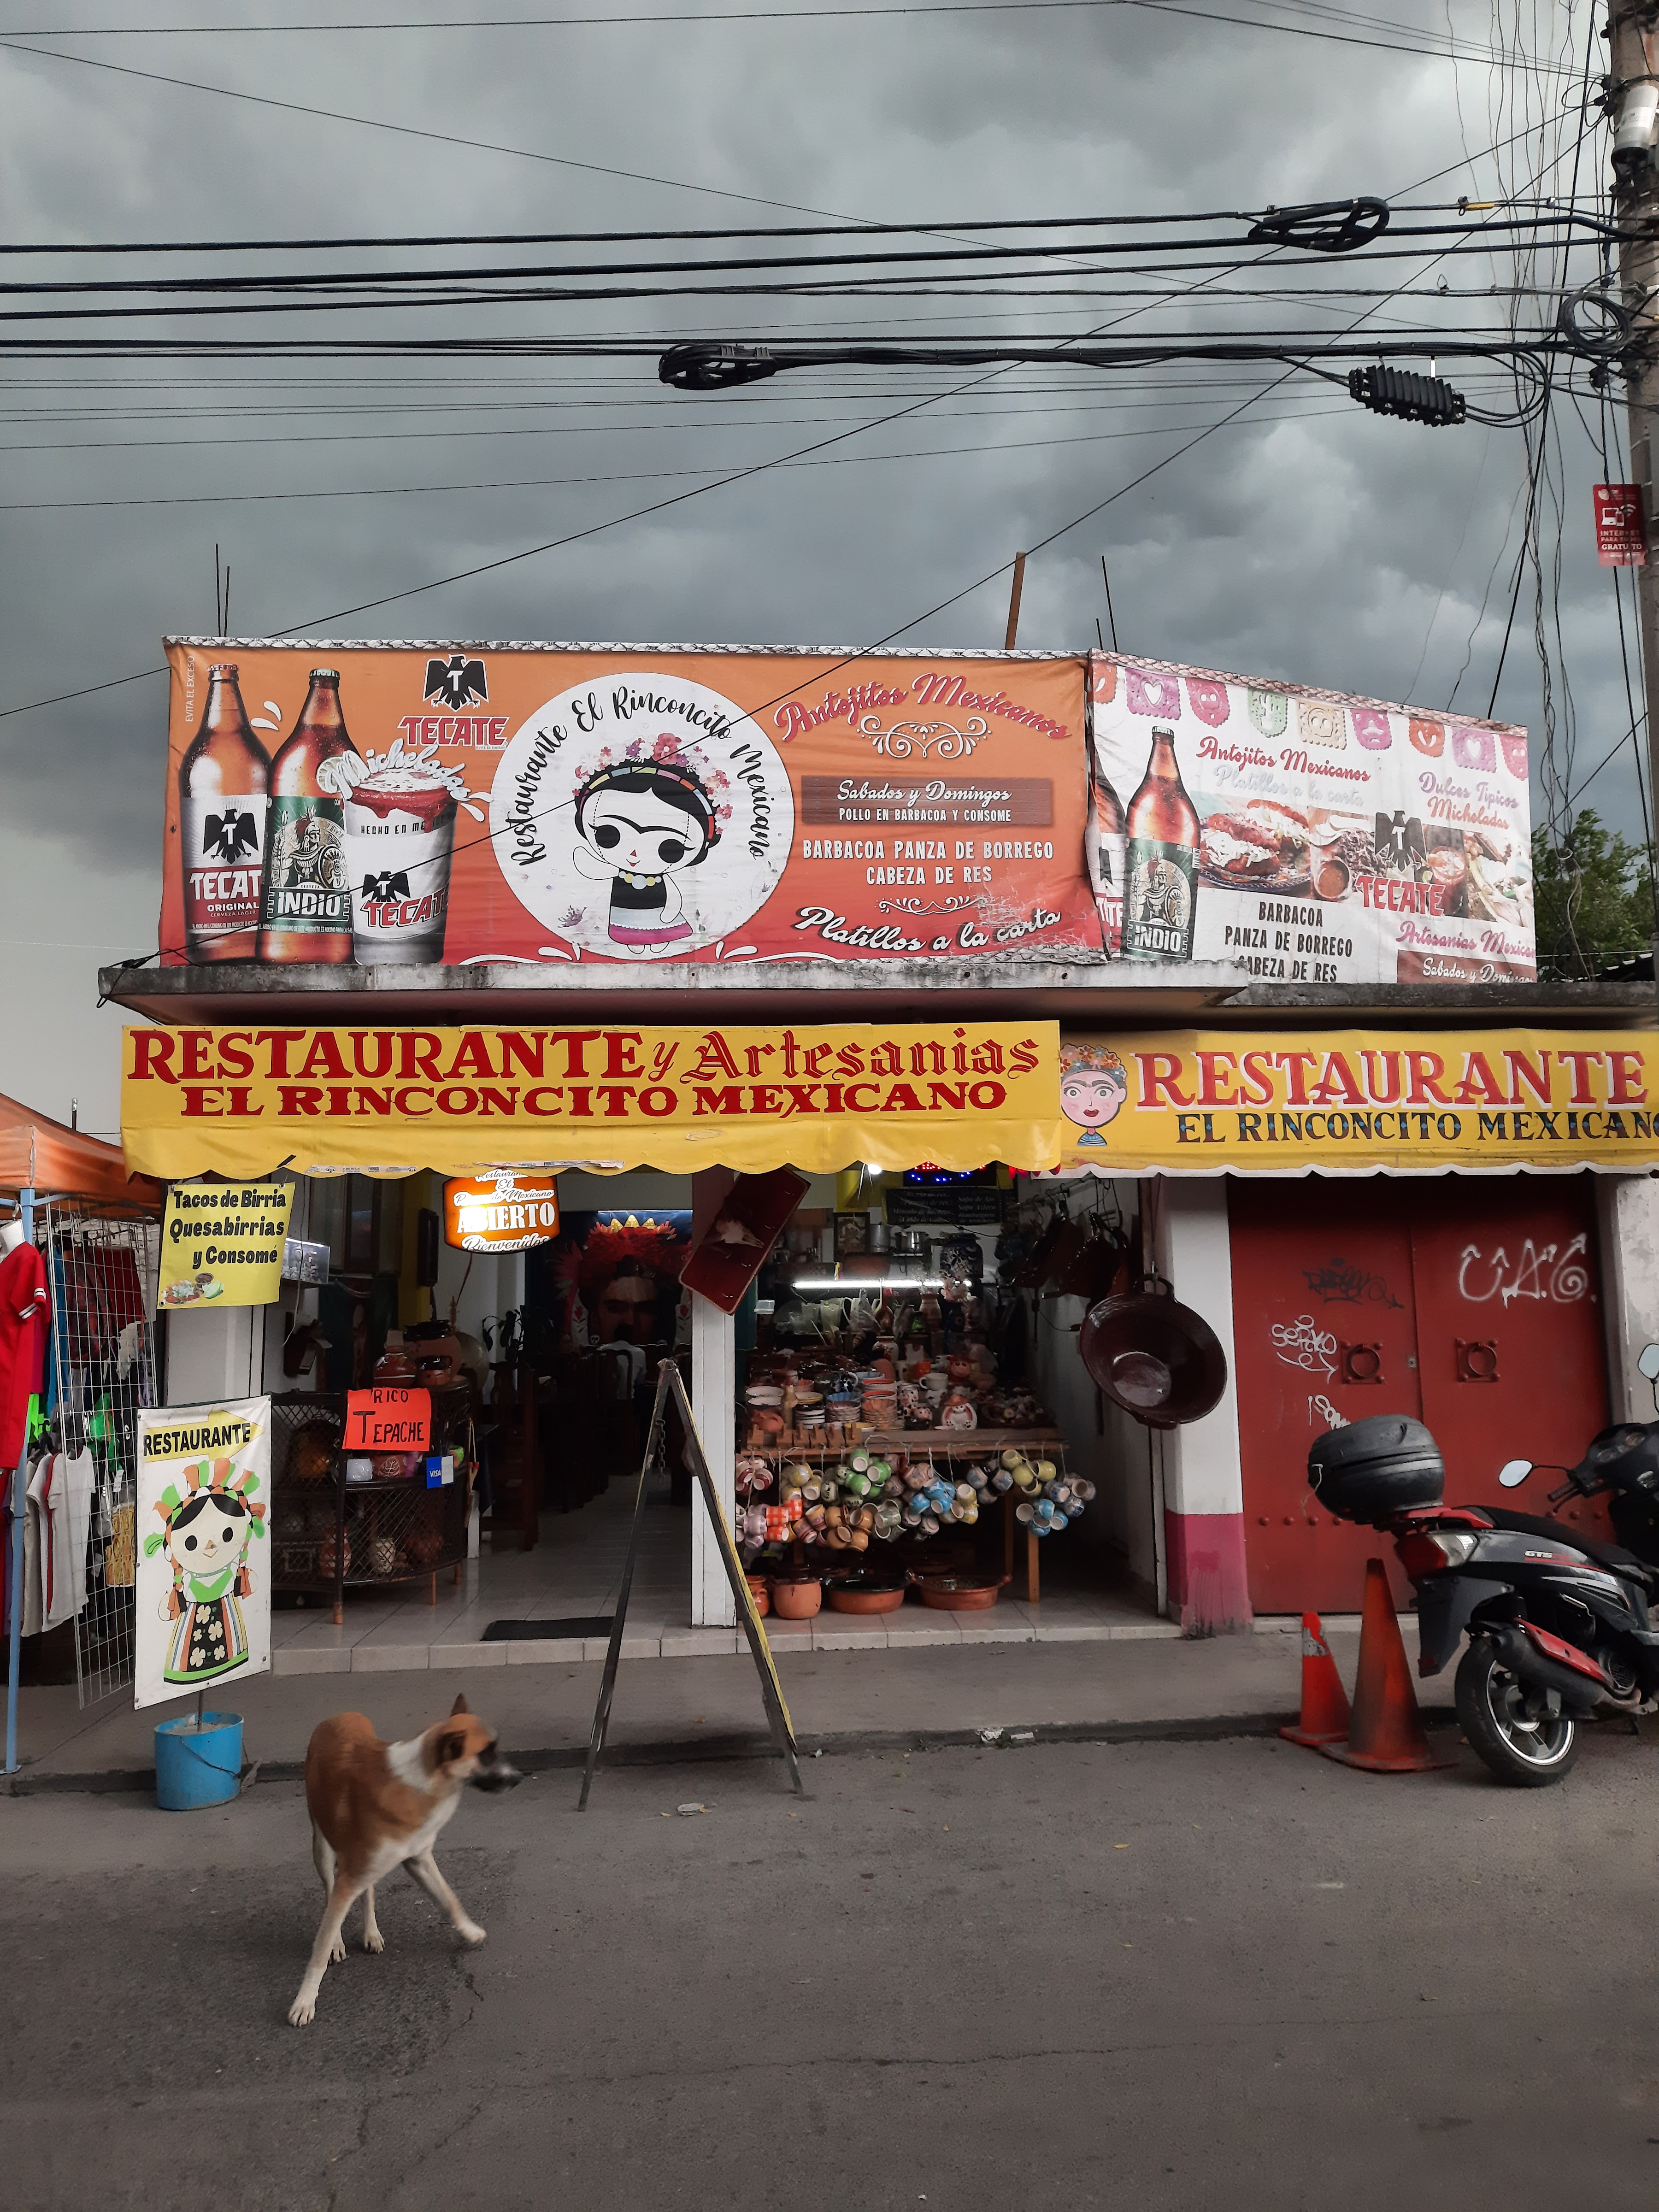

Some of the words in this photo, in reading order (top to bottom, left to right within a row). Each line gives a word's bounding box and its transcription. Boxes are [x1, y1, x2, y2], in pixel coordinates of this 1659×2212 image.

[186, 688, 194, 698] EL
[186, 700, 194, 722] EVITA
[774, 681, 909, 742] Antojitos
[912, 673, 1073, 740] Mexicanos
[397, 715, 510, 746] TECATE
[324, 737, 471, 801] Micheladas
[1196, 736, 1277, 771] Antojitos
[1280, 748, 1371, 782] Mexicanos
[505, 724, 567, 866] Restaurante
[571, 692, 603, 732] El
[612, 686, 734, 739] Rinconcito
[729, 743, 775, 861] Mexicano
[1214, 764, 1288, 795] Platillos
[1293, 787, 1303, 797] a
[1308, 780, 1323, 800] la
[1327, 789, 1364, 807] carta
[836, 780, 906, 801] Sabados
[909, 789, 921, 807] y
[925, 780, 1012, 808] Domingos
[1419, 771, 1471, 799] Dulces
[1476, 782, 1519, 809] Tipicos
[838, 808, 871, 821] POLLO
[876, 808, 890, 821] EN
[894, 809, 947, 821] BARBACOA
[952, 809, 959, 821] Y
[963, 810, 1012, 822] CONSOME
[1427, 796, 1509, 830] Micheladas
[361, 825, 389, 835] HECHO
[395, 824, 406, 834] EN
[803, 840, 885, 859] BARBACOA
[894, 841, 947, 860] PANZA
[955, 841, 975, 860] DE
[983, 841, 1054, 860] BORREGO
[866, 866, 926, 885] CABEZA
[935, 866, 954, 884] DE
[963, 866, 993, 883] RES
[207, 902, 259, 912] ORIGINAL
[277, 892, 341, 917] INDIO
[1354, 875, 1447, 917] TECATE
[1259, 901, 1323, 927] BARBACOA
[795, 906, 926, 951] Platillos
[933, 937, 950, 951] a
[960, 923, 989, 947] la
[996, 909, 1061, 945] carta
[1134, 925, 1181, 952] INDIO
[1225, 925, 1267, 948] PANZA
[1275, 931, 1290, 951] DE
[1297, 934, 1353, 957] BORREGO
[1395, 920, 1477, 950] Artesanias
[1293, 960, 1308, 980] DE
[1314, 963, 1337, 982] RES
[1423, 957, 1467, 979] Sabados
[127, 1029, 645, 1084] RESTAURANTE
[647, 1041, 680, 1082] y
[680, 1027, 1039, 1084] Artesanias
[1135, 1050, 1649, 1111] RESTAURANTE
[181, 1085, 265, 1116] EL
[277, 1085, 679, 1118] RINCONCITO
[692, 1080, 1008, 1118] MEXICANO
[1176, 1112, 1227, 1143] EL
[1237, 1111, 1461, 1141] RINCONCITO
[1477, 1111, 1659, 1141] MEXICAN
[498, 1179, 512, 1189] El
[505, 1189, 554, 1200] Mexicano
[174, 1190, 218, 1209] Tacos
[220, 1189, 239, 1207] de
[241, 1188, 286, 1208] Birria
[170, 1216, 284, 1243] Quesabirrias
[192, 1251, 202, 1270] y
[206, 1245, 278, 1264] Consomé
[373, 1389, 409, 1403] RICO
[143, 1422, 251, 1457] RESTAURANTE
[353, 1411, 424, 1443] TEPACHE
[429, 1469, 441, 1477] VISA
[1524, 1550, 1553, 1559] GTS
